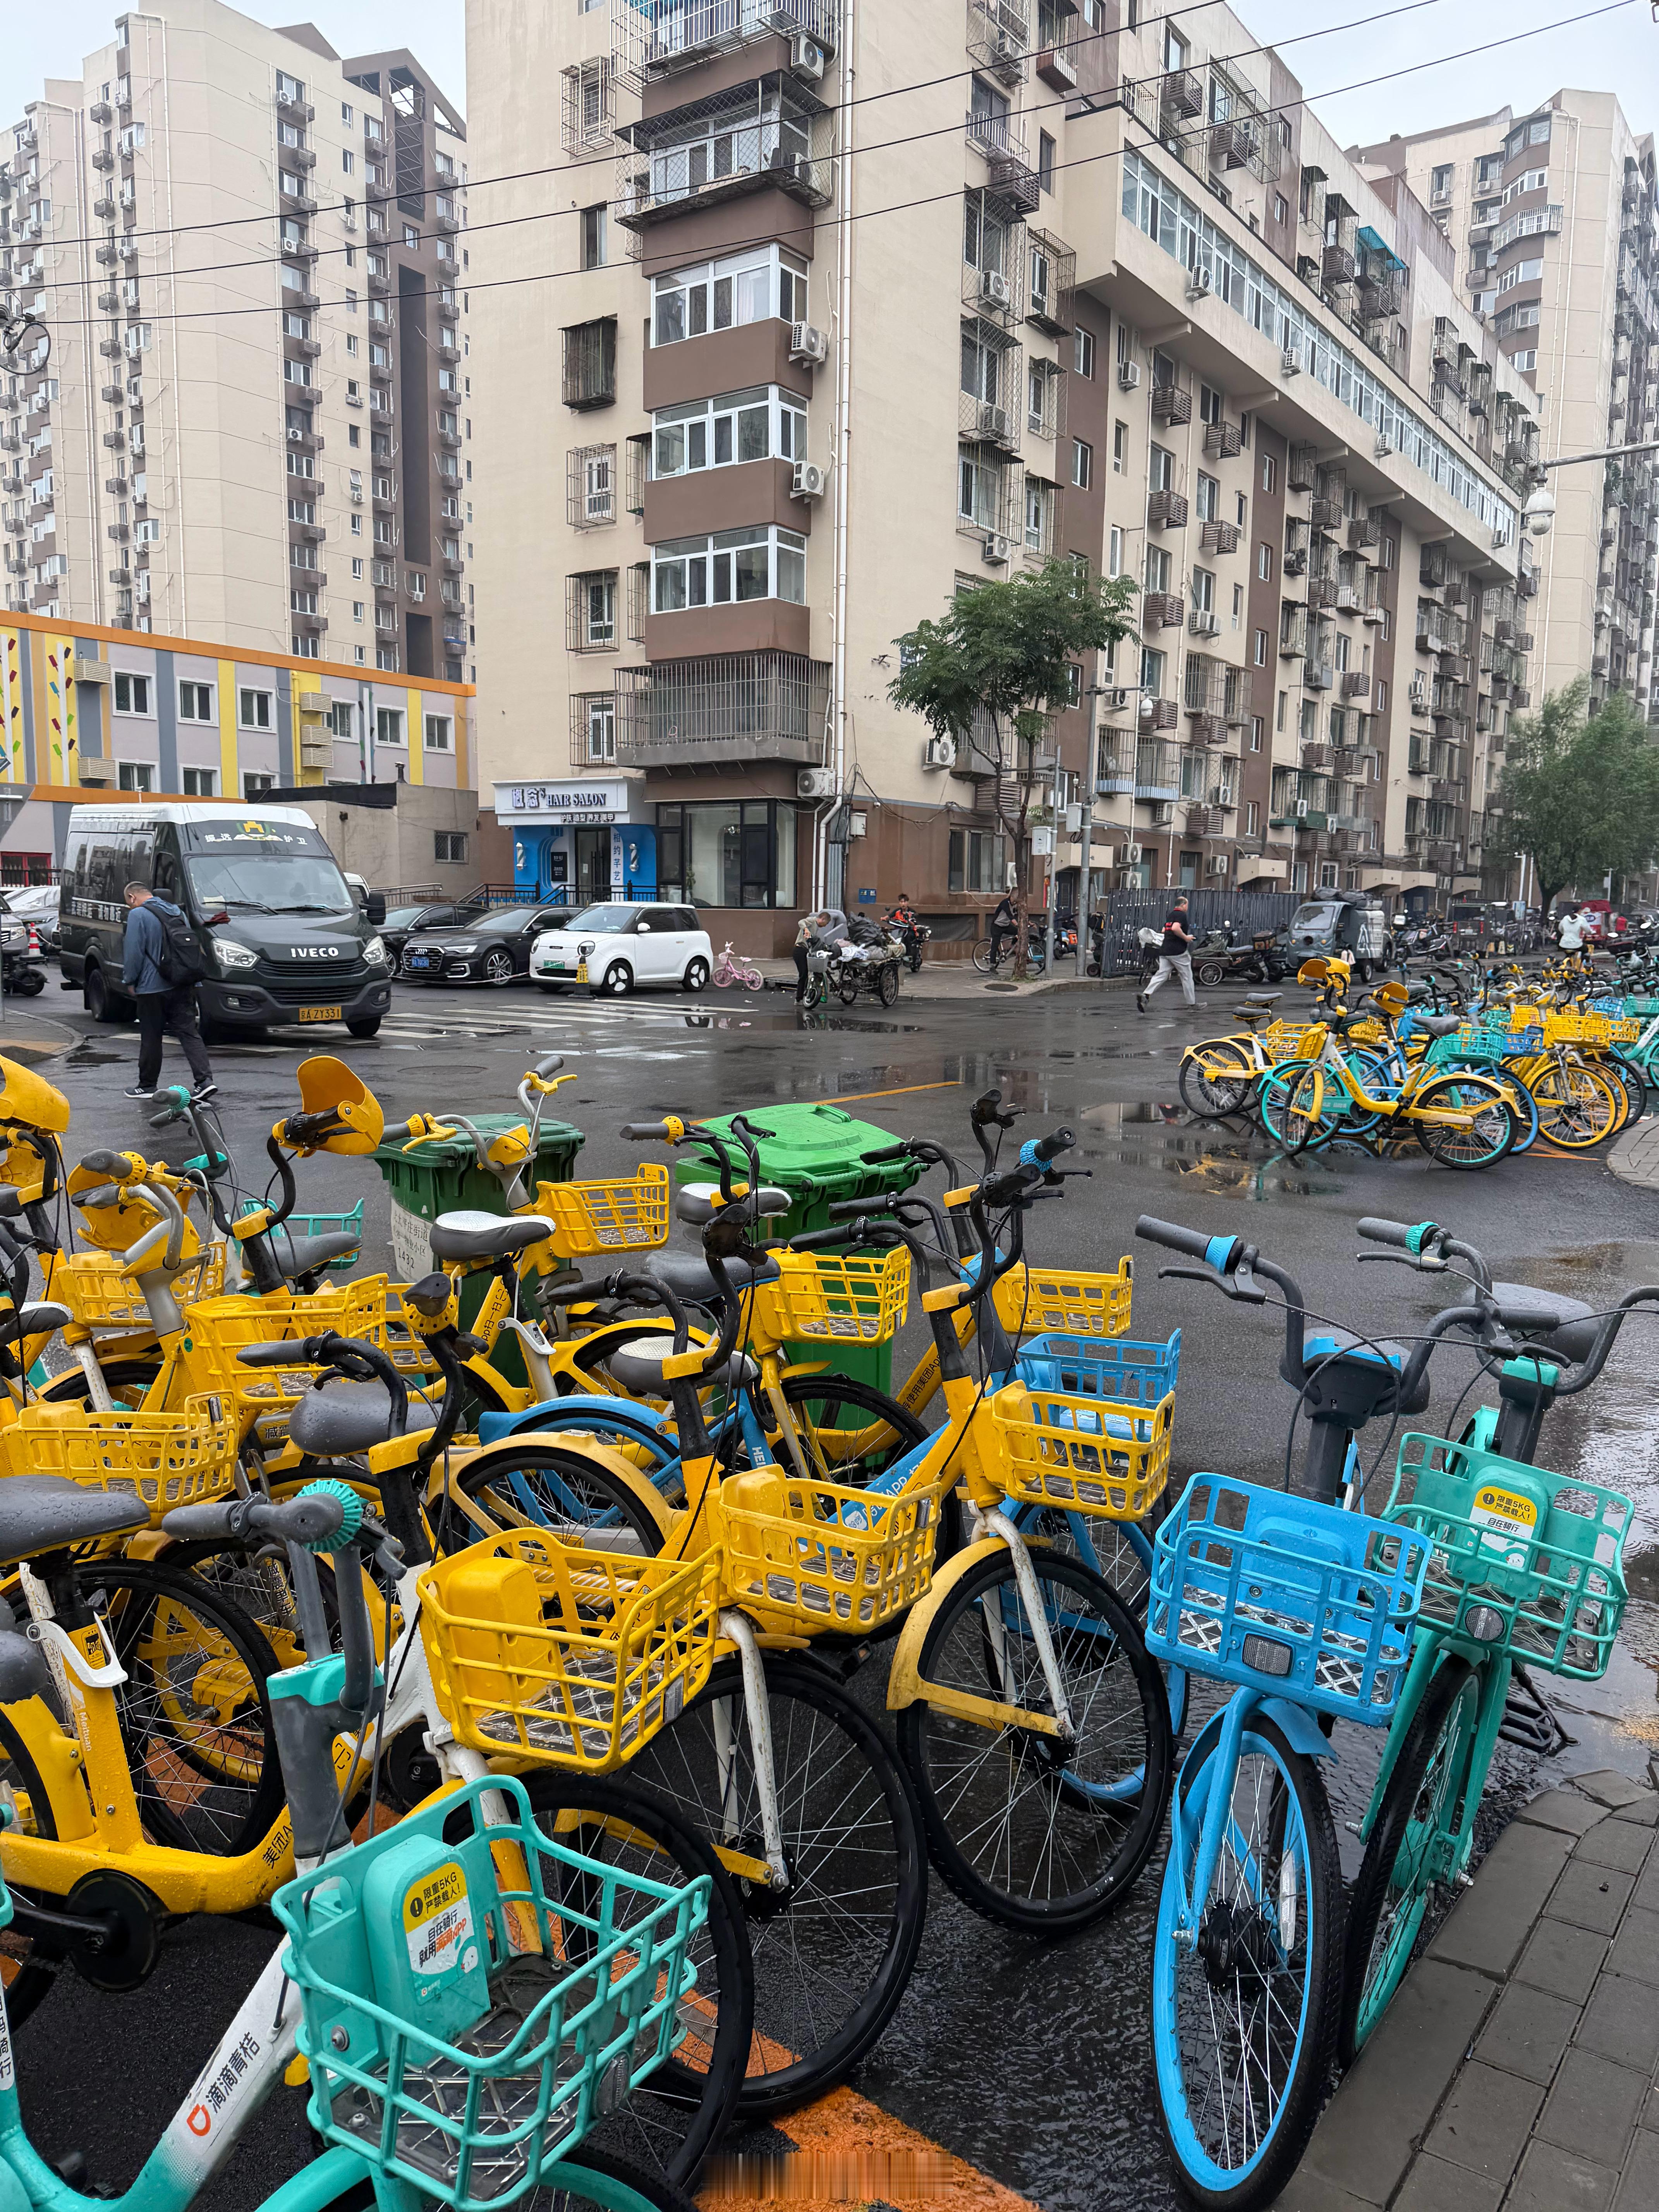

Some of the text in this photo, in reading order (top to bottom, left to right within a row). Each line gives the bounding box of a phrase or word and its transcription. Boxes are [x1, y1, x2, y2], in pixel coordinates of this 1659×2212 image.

[546, 793, 606, 806] HAIR SALON
[291, 947, 339, 958] IVECO
[398, 1247, 414, 1269] 1432
[1497, 1495, 1530, 1512] 限重5KG
[1487, 1518, 1520, 1532] 自在骑行
[79, 1712, 92, 1751] Meituan
[423, 1871, 457, 1901] 限重5KG
[428, 1909, 458, 1943] 自在骑行
[206, 2031, 260, 2114] 滴滴青桔
